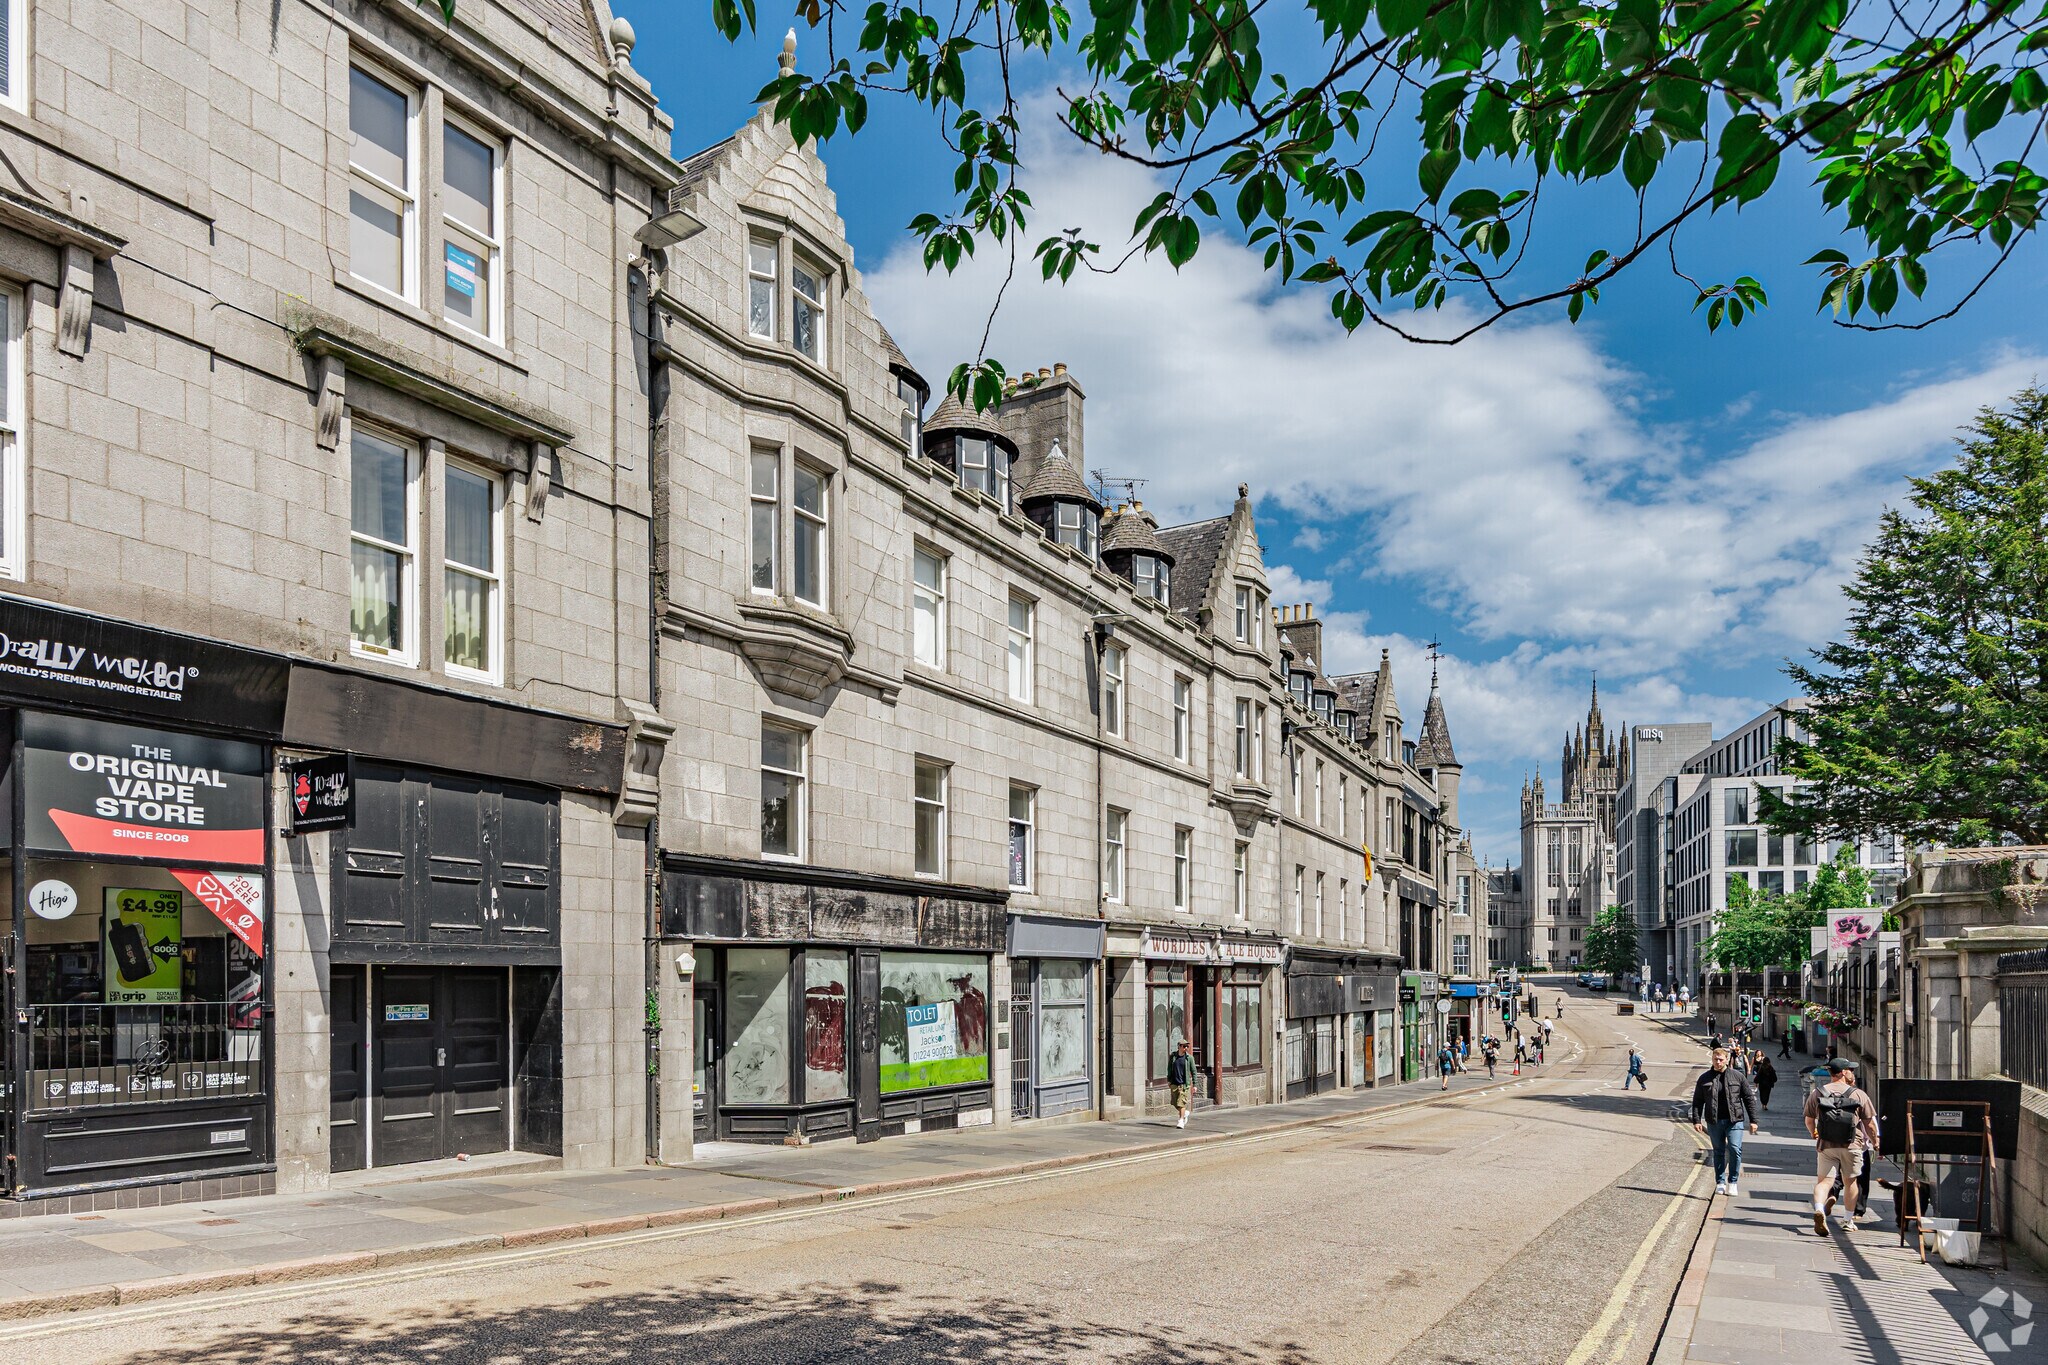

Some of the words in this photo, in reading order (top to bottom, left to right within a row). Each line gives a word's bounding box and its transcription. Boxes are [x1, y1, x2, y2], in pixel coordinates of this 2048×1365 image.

[49, 671, 96, 687] PREMIER
[97, 679, 135, 694] VAPING
[135, 686, 182, 701] RETAILER
[131, 744, 171, 761] THE
[69, 752, 227, 788] ORIGINAL
[107, 777, 194, 804] VAPE
[96, 797, 204, 825] STORE
[112, 829, 153, 840] SINCE
[155, 832, 189, 843] 2008
[228, 881, 254, 905] HERE
[235, 875, 260, 899] SOLD
[39, 890, 68, 911] Higo
[123, 898, 178, 914] £4.99
[225, 916, 250, 941] VAPORESSO
[154, 945, 178, 953] 6000
[1152, 937, 1206, 955] WORDIES
[1226, 942, 1245, 957] ALE
[1247, 943, 1277, 959] HOUSE
[122, 991, 146, 1002] grip
[908, 1009, 922, 1023] TO
[923, 1007, 937, 1021] LET
[913, 1050, 931, 1061] 01224
